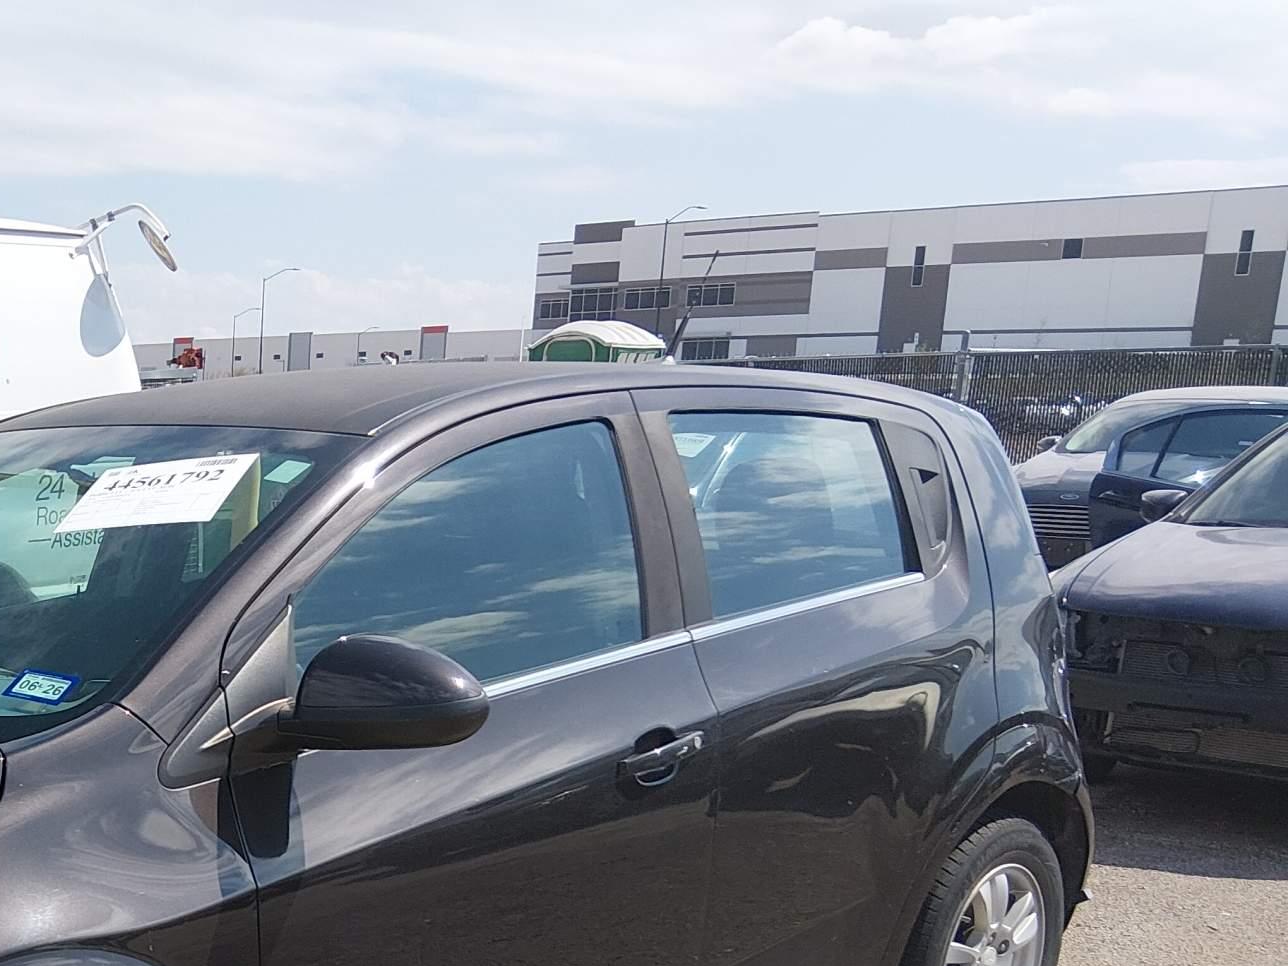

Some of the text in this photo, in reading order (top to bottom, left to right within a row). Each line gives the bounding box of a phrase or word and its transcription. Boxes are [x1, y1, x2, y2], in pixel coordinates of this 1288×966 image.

[35, 474, 66, 502] 24
[104, 469, 224, 490] 44561792
[41, 683, 65, 697] 26
